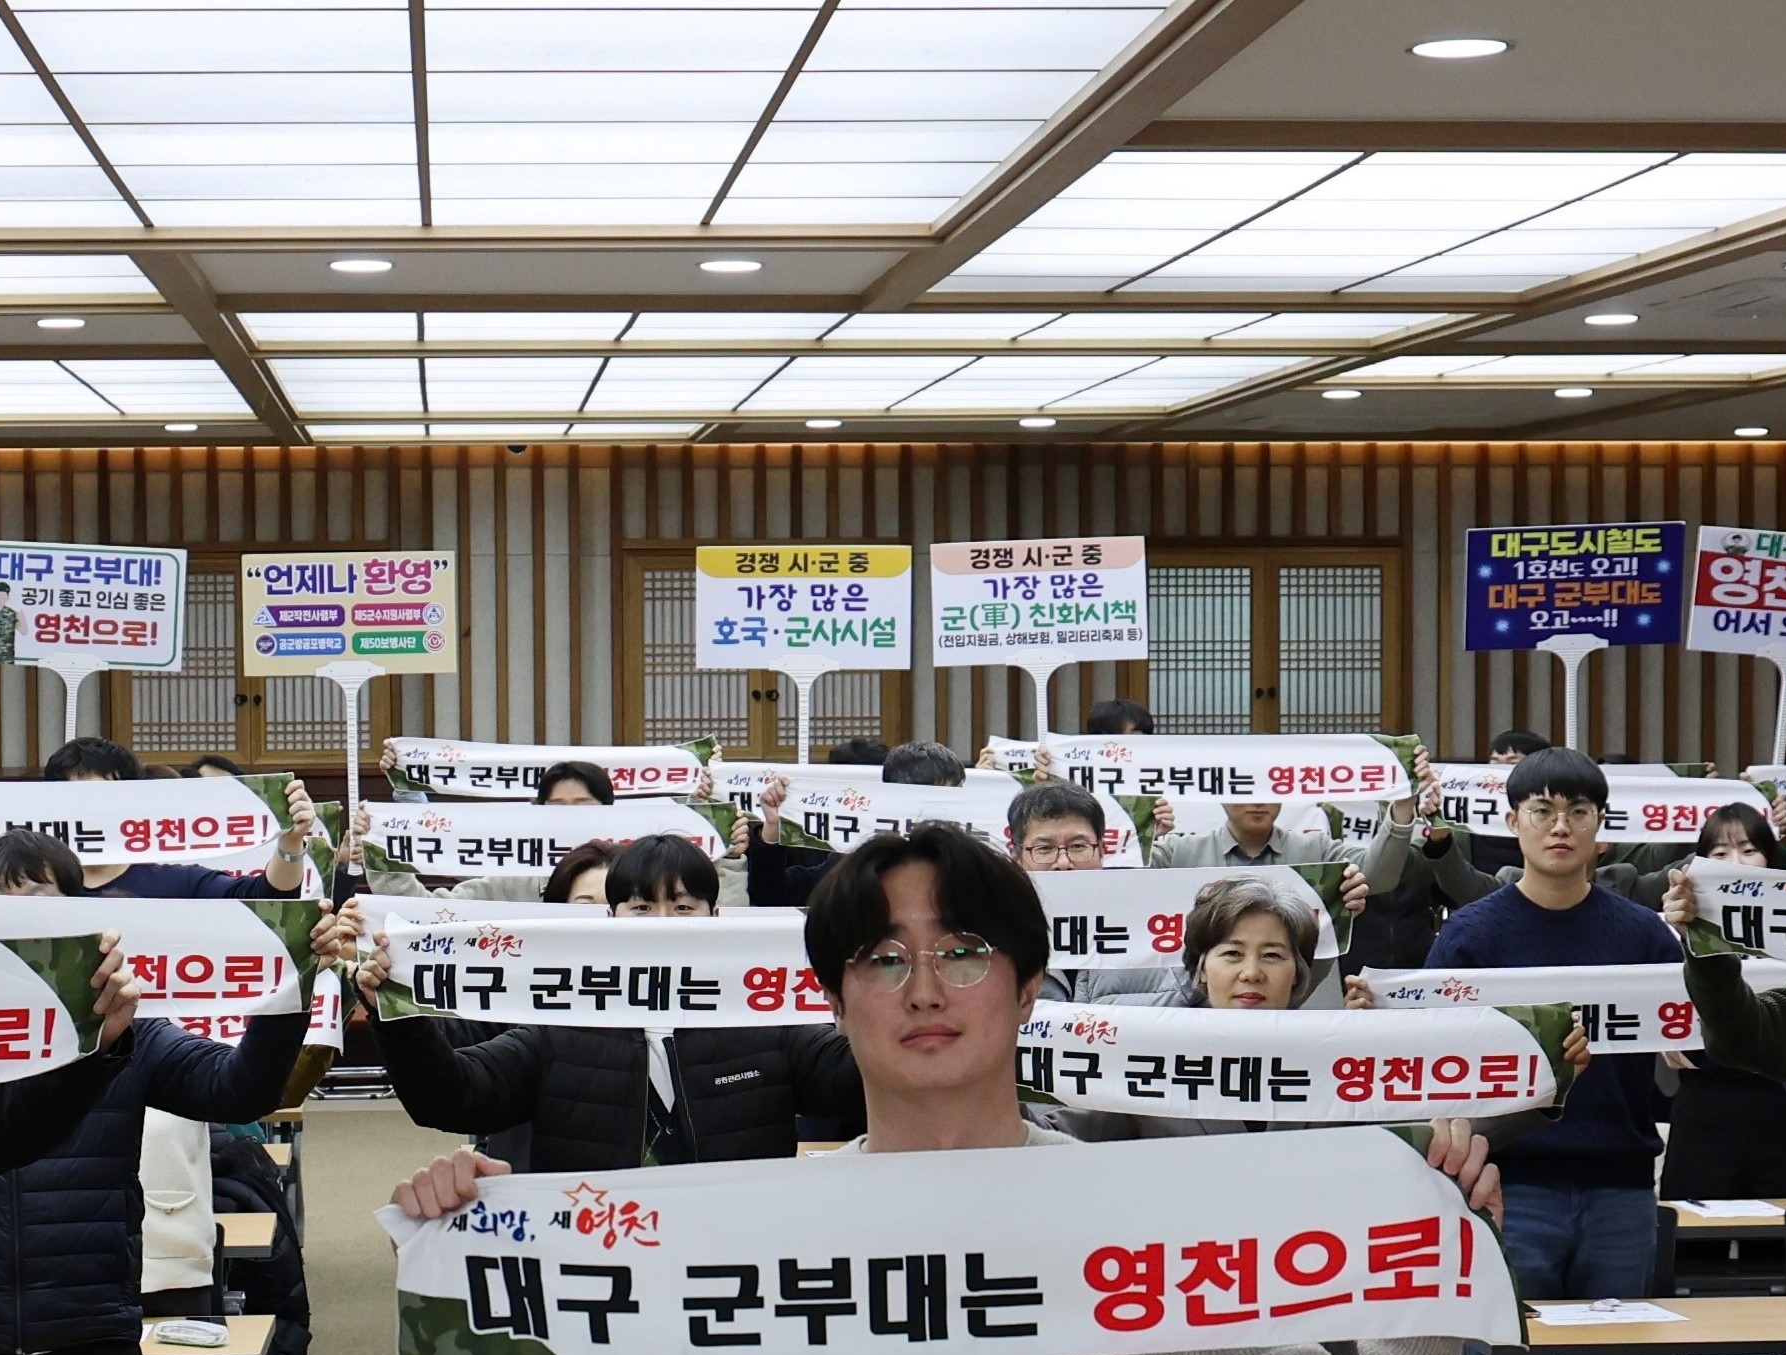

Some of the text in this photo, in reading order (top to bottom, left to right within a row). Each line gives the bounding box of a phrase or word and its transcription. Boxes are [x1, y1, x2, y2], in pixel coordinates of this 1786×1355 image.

[970, 547, 1013, 570] 경쟁
[1081, 544, 1103, 566] 중
[1490, 527, 1662, 558] 대구도시철도
[63, 555, 162, 587] 군부대!
[735, 552, 780, 574] 경쟁
[849, 552, 869, 574] 중
[1514, 556, 1639, 579] 1호선도 오고!
[21, 587, 166, 613] 공기 좋고 인심 좋은
[737, 583, 869, 613] 가장 많은
[983, 573, 1104, 601] 가장 많은
[1488, 581, 1662, 609] 대구 군부대도
[34, 613, 158, 646] 영천으로!
[940, 600, 1137, 631] 군(軍) 친화시책
[1713, 610, 1771, 637] 어서
[406, 764, 699, 790] 대구 군부대 천으로!
[1069, 764, 1396, 796] 대구 군부대는 영천으로!
[1443, 796, 1499, 824] 대구
[120, 814, 269, 852] 영천으로!
[804, 812, 861, 844] 대구
[386, 835, 444, 864] 대구
[127, 954, 283, 999] 천으로!
[413, 963, 720, 1011] 대구 군부대는
[1015, 1046, 1537, 1103] 대구 군부대는 영천으로!
[465, 1216, 1473, 1348] 대구 군부대는 영천으로!
